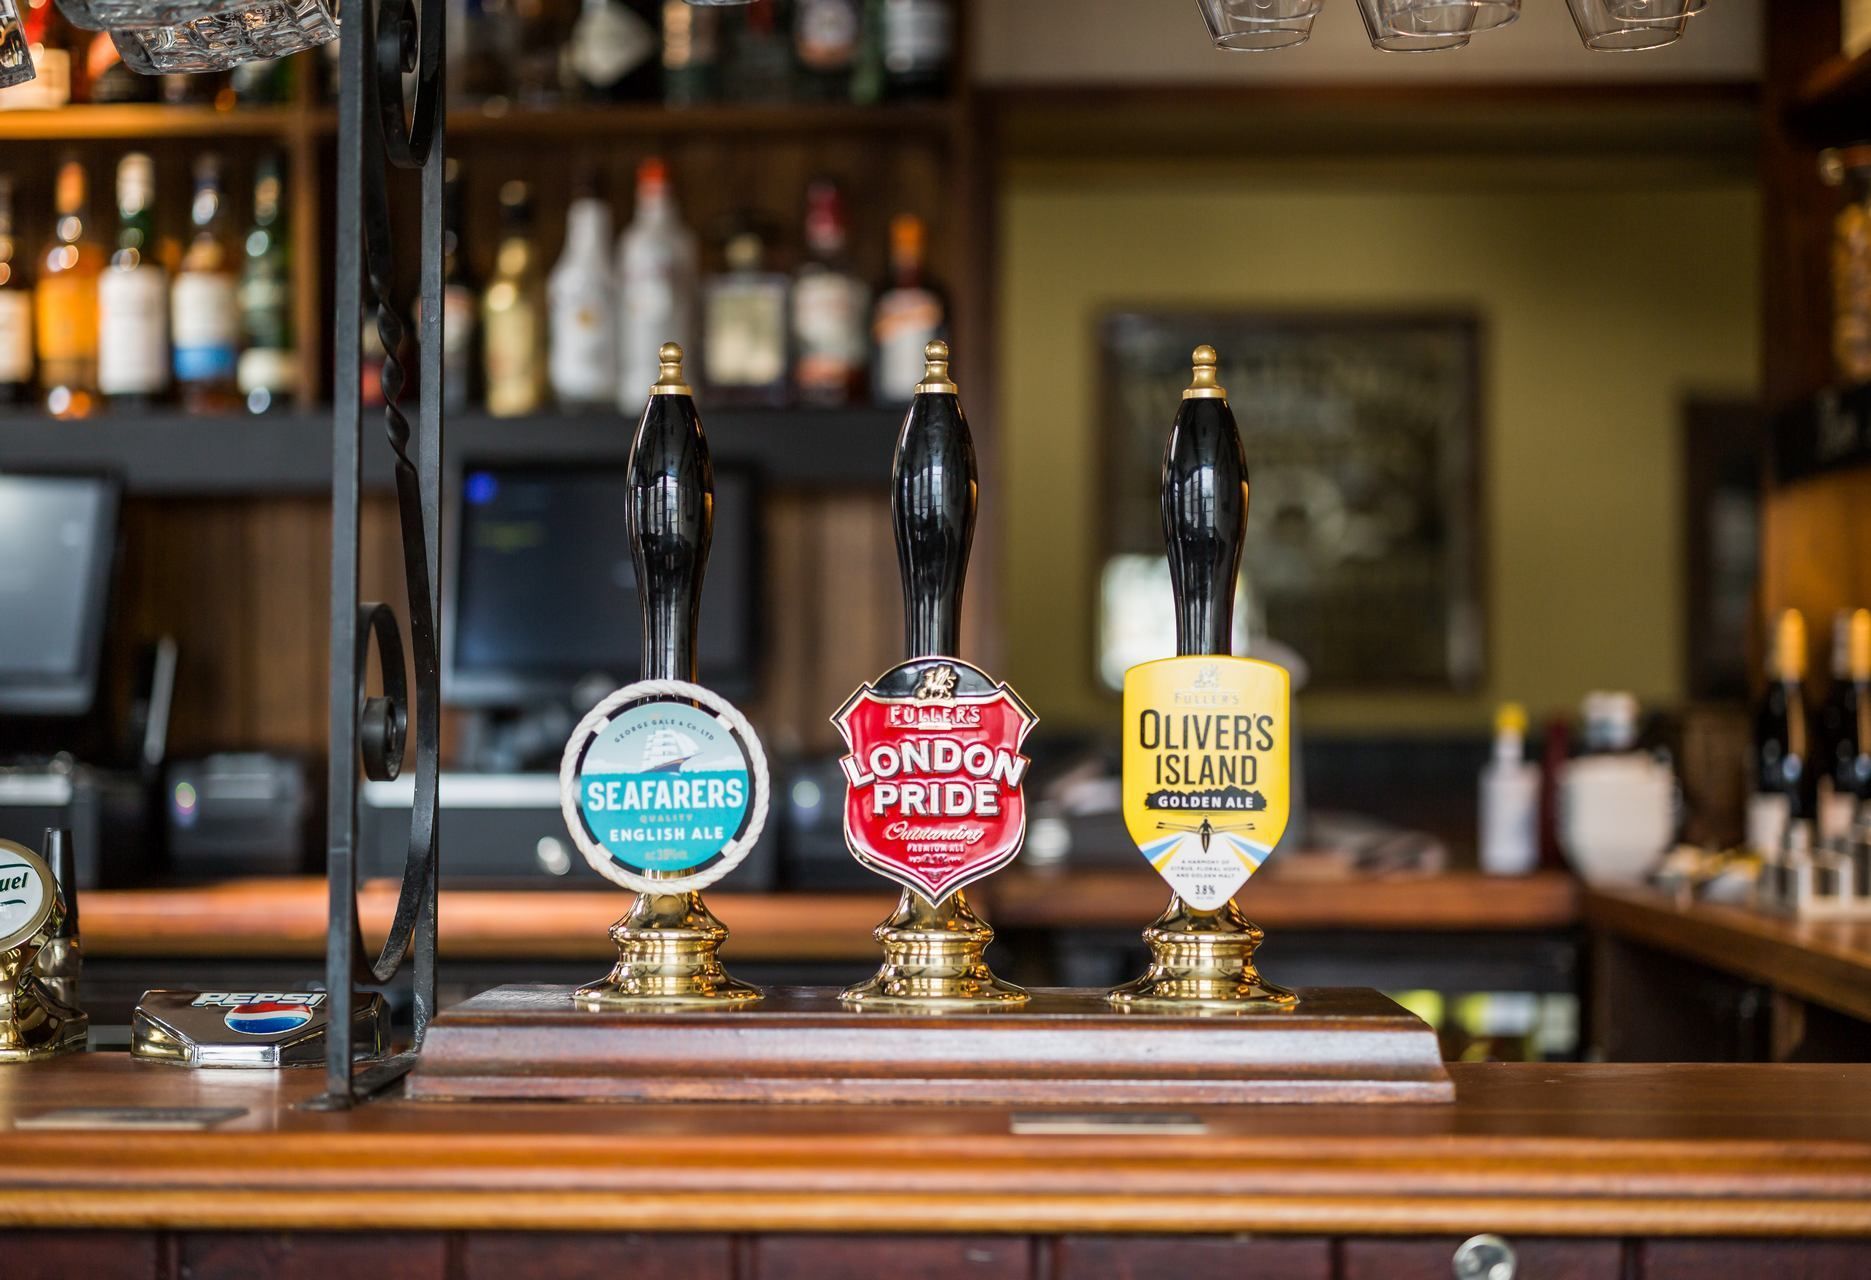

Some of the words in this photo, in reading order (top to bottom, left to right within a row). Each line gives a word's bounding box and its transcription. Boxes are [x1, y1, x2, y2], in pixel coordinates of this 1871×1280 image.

[889, 705, 982, 724] FULLER'S
[614, 721, 649, 743] GEORGE
[1140, 709, 1274, 752] OLIVER'S
[844, 738, 1027, 790] LONDON
[1156, 755, 1258, 786] ISLAND
[587, 778, 743, 812] SEAFARERS
[873, 783, 1000, 816] PRIDE
[1158, 796, 1222, 809] GOLDEN
[1225, 796, 1254, 809] ALE
[639, 813, 693, 824] QUALITY
[609, 827, 686, 842] ENGLISH
[691, 826, 724, 840] ALE
[884, 820, 985, 845] Outstanding
[906, 843, 946, 853] PREMIUM
[191, 992, 328, 1007] PEPSI
